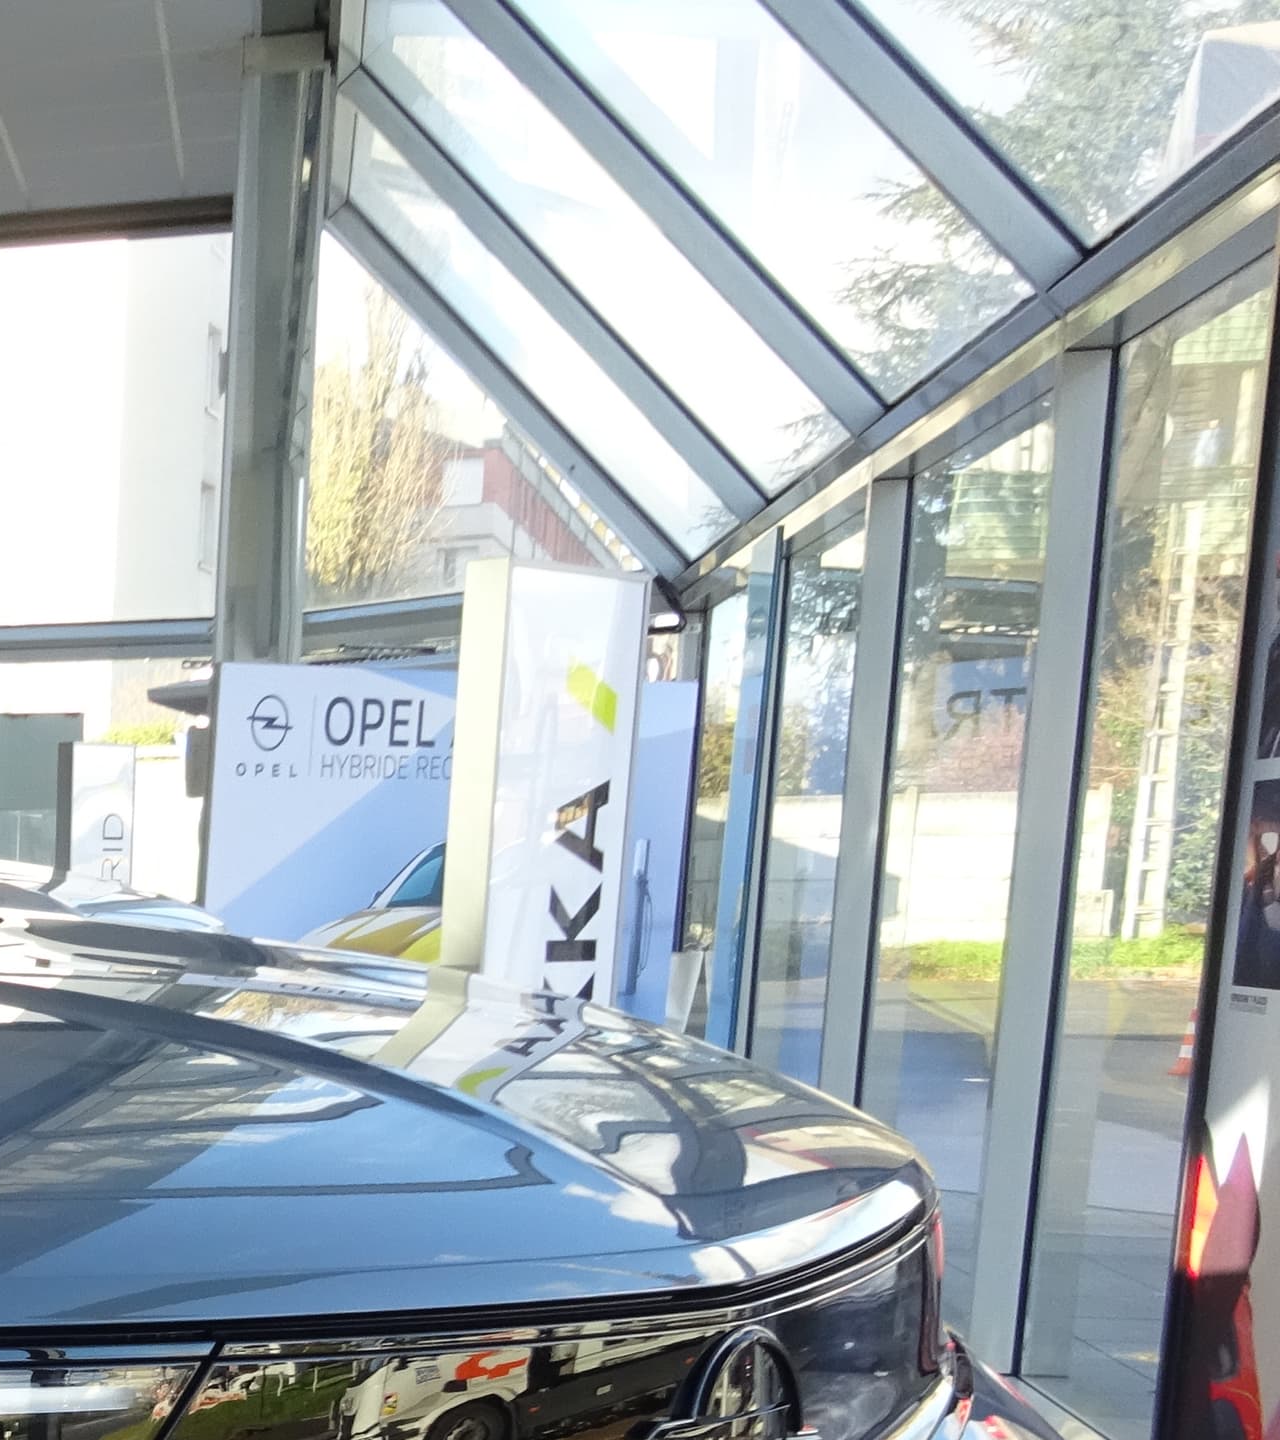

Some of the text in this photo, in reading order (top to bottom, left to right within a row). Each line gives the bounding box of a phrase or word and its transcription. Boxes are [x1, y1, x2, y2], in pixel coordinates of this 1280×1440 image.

[324, 696, 435, 748] OPEL
[235, 762, 298, 778] OPEL
[320, 754, 409, 780] HYBRIDE
